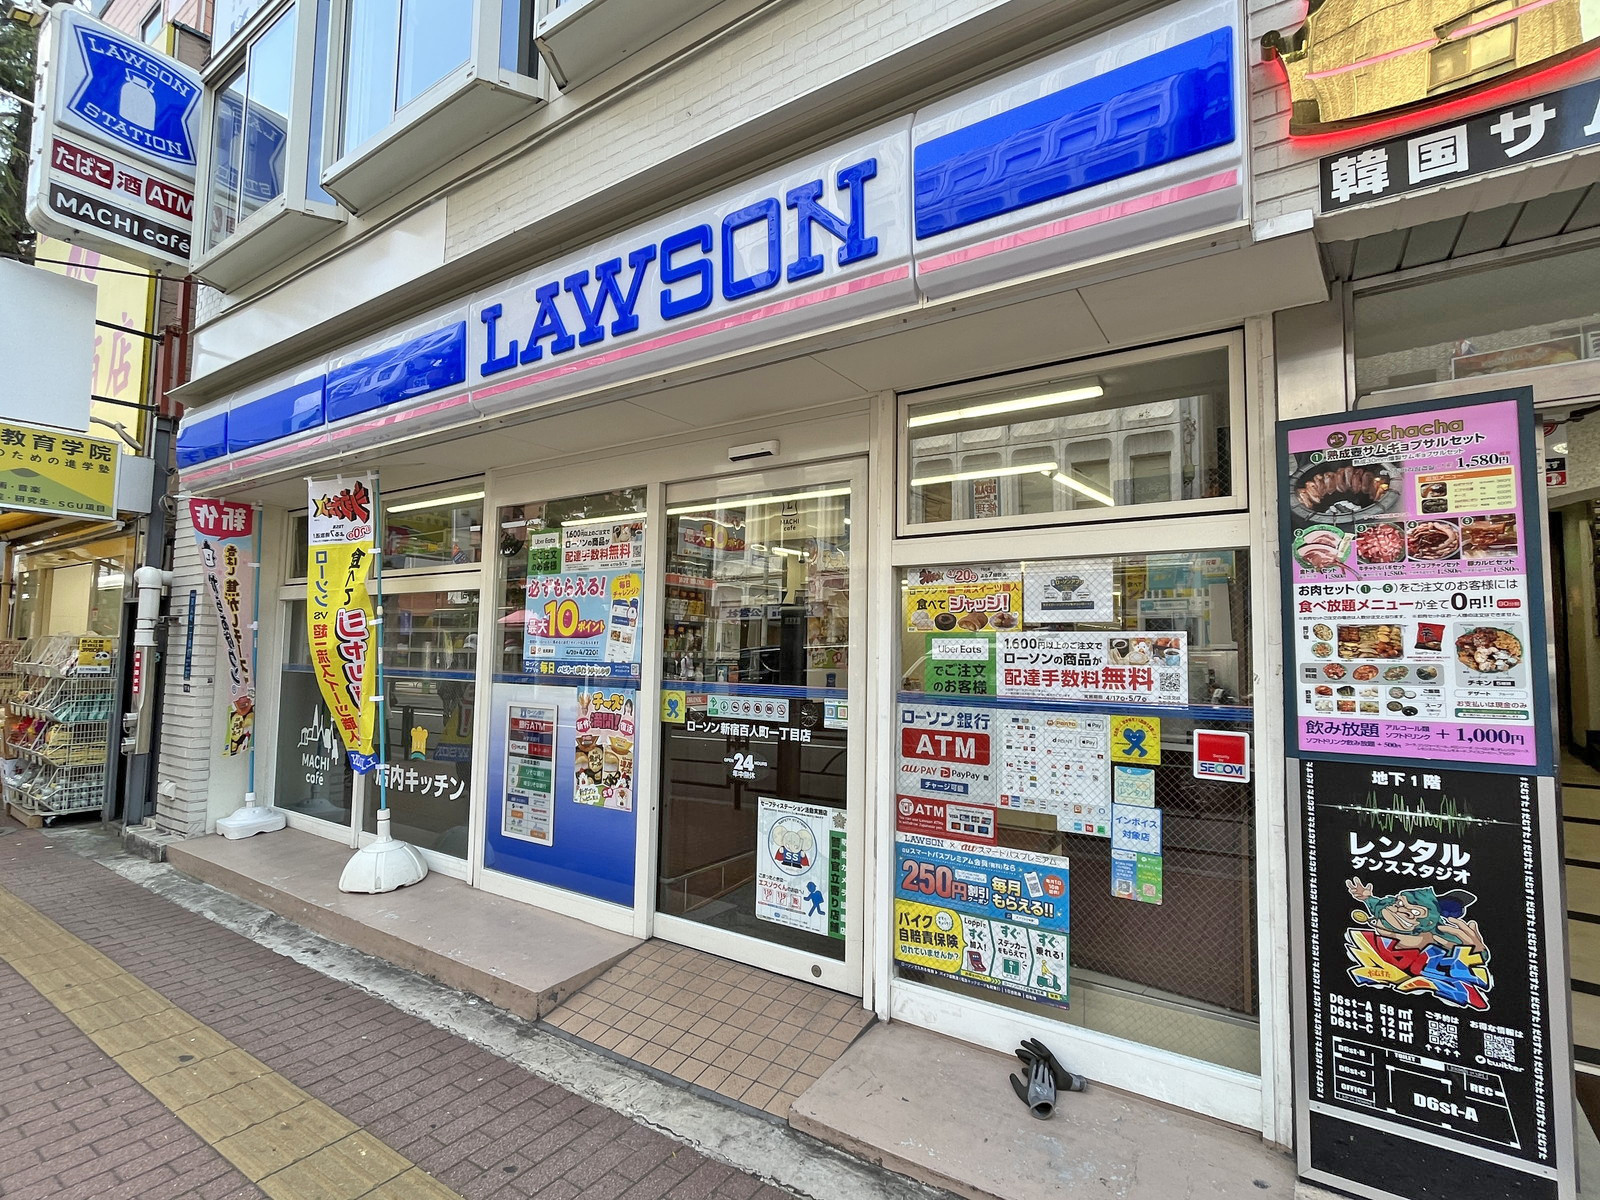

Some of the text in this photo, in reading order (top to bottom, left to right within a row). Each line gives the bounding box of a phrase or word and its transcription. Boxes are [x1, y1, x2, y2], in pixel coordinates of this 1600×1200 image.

[87, 36, 190, 97] LAWSON
[84, 102, 184, 156] STATION
[55, 146, 111, 185] たばこ
[117, 171, 142, 197] 酒
[148, 186, 194, 216] ATM
[57, 193, 190, 252] MACHI café
[481, 158, 878, 376] LAWSON
[1349, 419, 1464, 445] 75chacha
[1457, 453, 1509, 469] 1,580円
[781, 518, 800, 526] MACHI
[566, 537, 610, 549] ローソンの商品が
[565, 543, 631, 563] 配達手数料無料
[528, 576, 606, 598] 必ずもらえる!
[917, 598, 946, 610] 食べて
[949, 594, 1010, 612] ジャッジ!
[544, 599, 579, 637] 10
[528, 620, 547, 634] 最大
[577, 620, 605, 632] ポイント
[938, 644, 982, 654] Uber Eats
[1004, 653, 1102, 666] ローソンの商品が
[540, 661, 555, 674] 毎日
[933, 663, 986, 677] でご注文
[1004, 666, 1154, 691] 配達手数料無料
[933, 680, 988, 695] のお客様
[592, 692, 624, 710] チーズ
[576, 720, 590, 730] 新作
[902, 710, 990, 730] ローソン銀行
[620, 721, 633, 735] 復活
[687, 721, 811, 743] ローソン新宿百人町一丁目店
[1306, 720, 1379, 738] 飲み放題
[1385, 724, 1430, 733] アルコール類
[1385, 732, 1430, 740] ソフトドリンク
[1457, 728, 1524, 746] 1,000円
[916, 734, 975, 759] ATM
[302, 753, 330, 771] MACHI
[733, 753, 754, 771] 24
[1200, 763, 1242, 775] SECOM
[306, 772, 324, 786] café
[901, 765, 980, 781] au PAY PayPay
[375, 764, 465, 800] 店内キッチン
[925, 781, 964, 792] チャージ可能
[915, 803, 944, 817] ATM
[1116, 816, 1158, 829] インボイス
[904, 835, 944, 848] LAWSON
[1123, 830, 1149, 842] 対象店
[786, 852, 799, 861] SS
[1350, 831, 1471, 867] レンタル
[1351, 856, 1471, 885] ダンススタジオ
[967, 885, 989, 900] 割引
[991, 876, 1021, 897] 毎月
[967, 896, 989, 905] クーポン
[899, 912, 933, 928] バイク
[899, 927, 959, 949] 自賠責保険
[998, 938, 1027, 949] ステッカー
[900, 945, 960, 961] 切れていませんか?
[970, 941, 987, 951] 加入!
[998, 947, 1027, 959] をもらえて!
[1036, 946, 1064, 960] 乗れる!
[1329, 993, 1372, 1012] D6st-A
[1379, 1004, 1395, 1015] 58
[1330, 1004, 1373, 1023] D6st-B
[1380, 1015, 1395, 1027] 12
[1425, 1010, 1459, 1025] ご予約は
[1330, 1016, 1374, 1034] D6st-C
[1381, 1027, 1395, 1040] 12
[1470, 1020, 1524, 1039] お得な情報は
[1338, 1044, 1366, 1057] D6st-B
[1394, 1052, 1415, 1062] TOILET
[1339, 1065, 1366, 1078] D6st-C
[1487, 1058, 1524, 1073] twitter
[1341, 1083, 1367, 1096] OFFICE
[1470, 1083, 1493, 1096] REC
[1414, 1092, 1479, 1122] D6st-A
